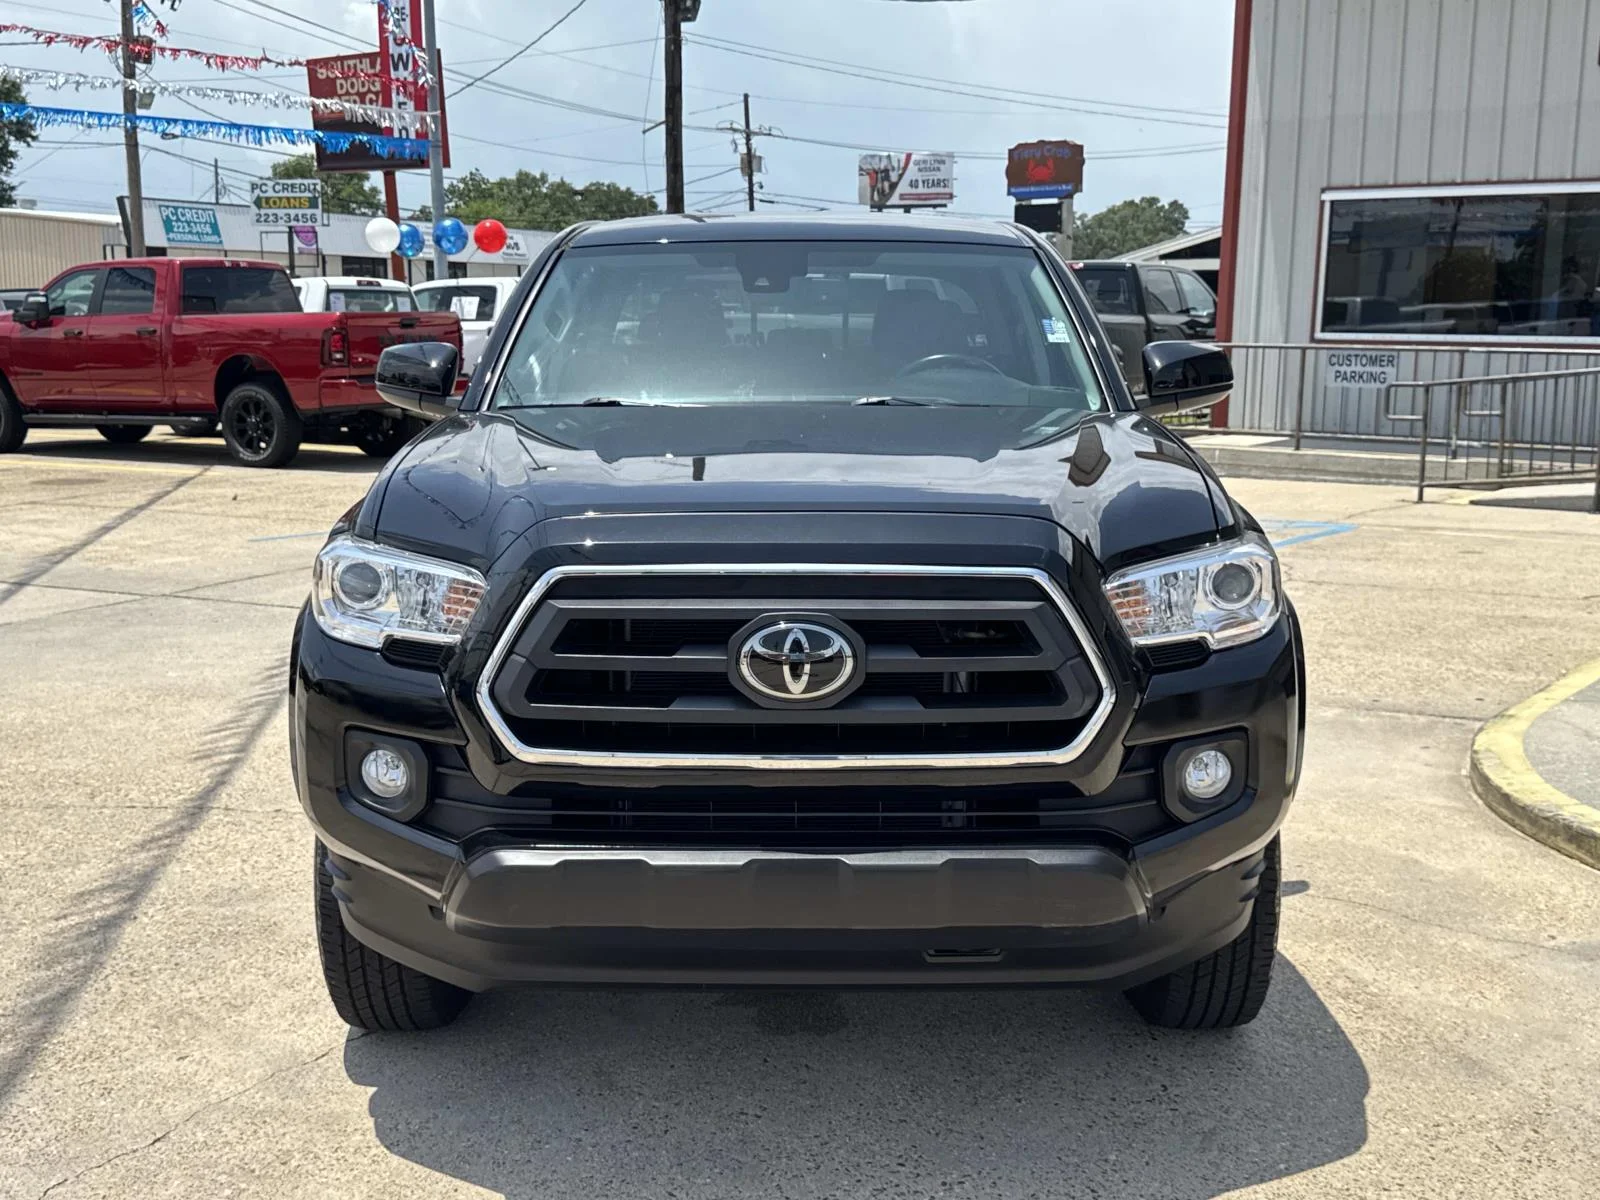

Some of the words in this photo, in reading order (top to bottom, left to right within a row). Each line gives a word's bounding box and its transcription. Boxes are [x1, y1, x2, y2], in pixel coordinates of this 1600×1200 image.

[251, 182, 269, 194] PC
[272, 182, 319, 195] CREDIT
[908, 178, 919, 190] 40
[261, 197, 310, 209] LOANS
[160, 206, 177, 220] PC
[177, 207, 215, 224] CREDIT
[256, 213, 318, 224] 223-3456
[172, 221, 212, 234] 223-3456
[1328, 353, 1395, 368] CUSTOMER
[1334, 370, 1387, 384] PARKING
